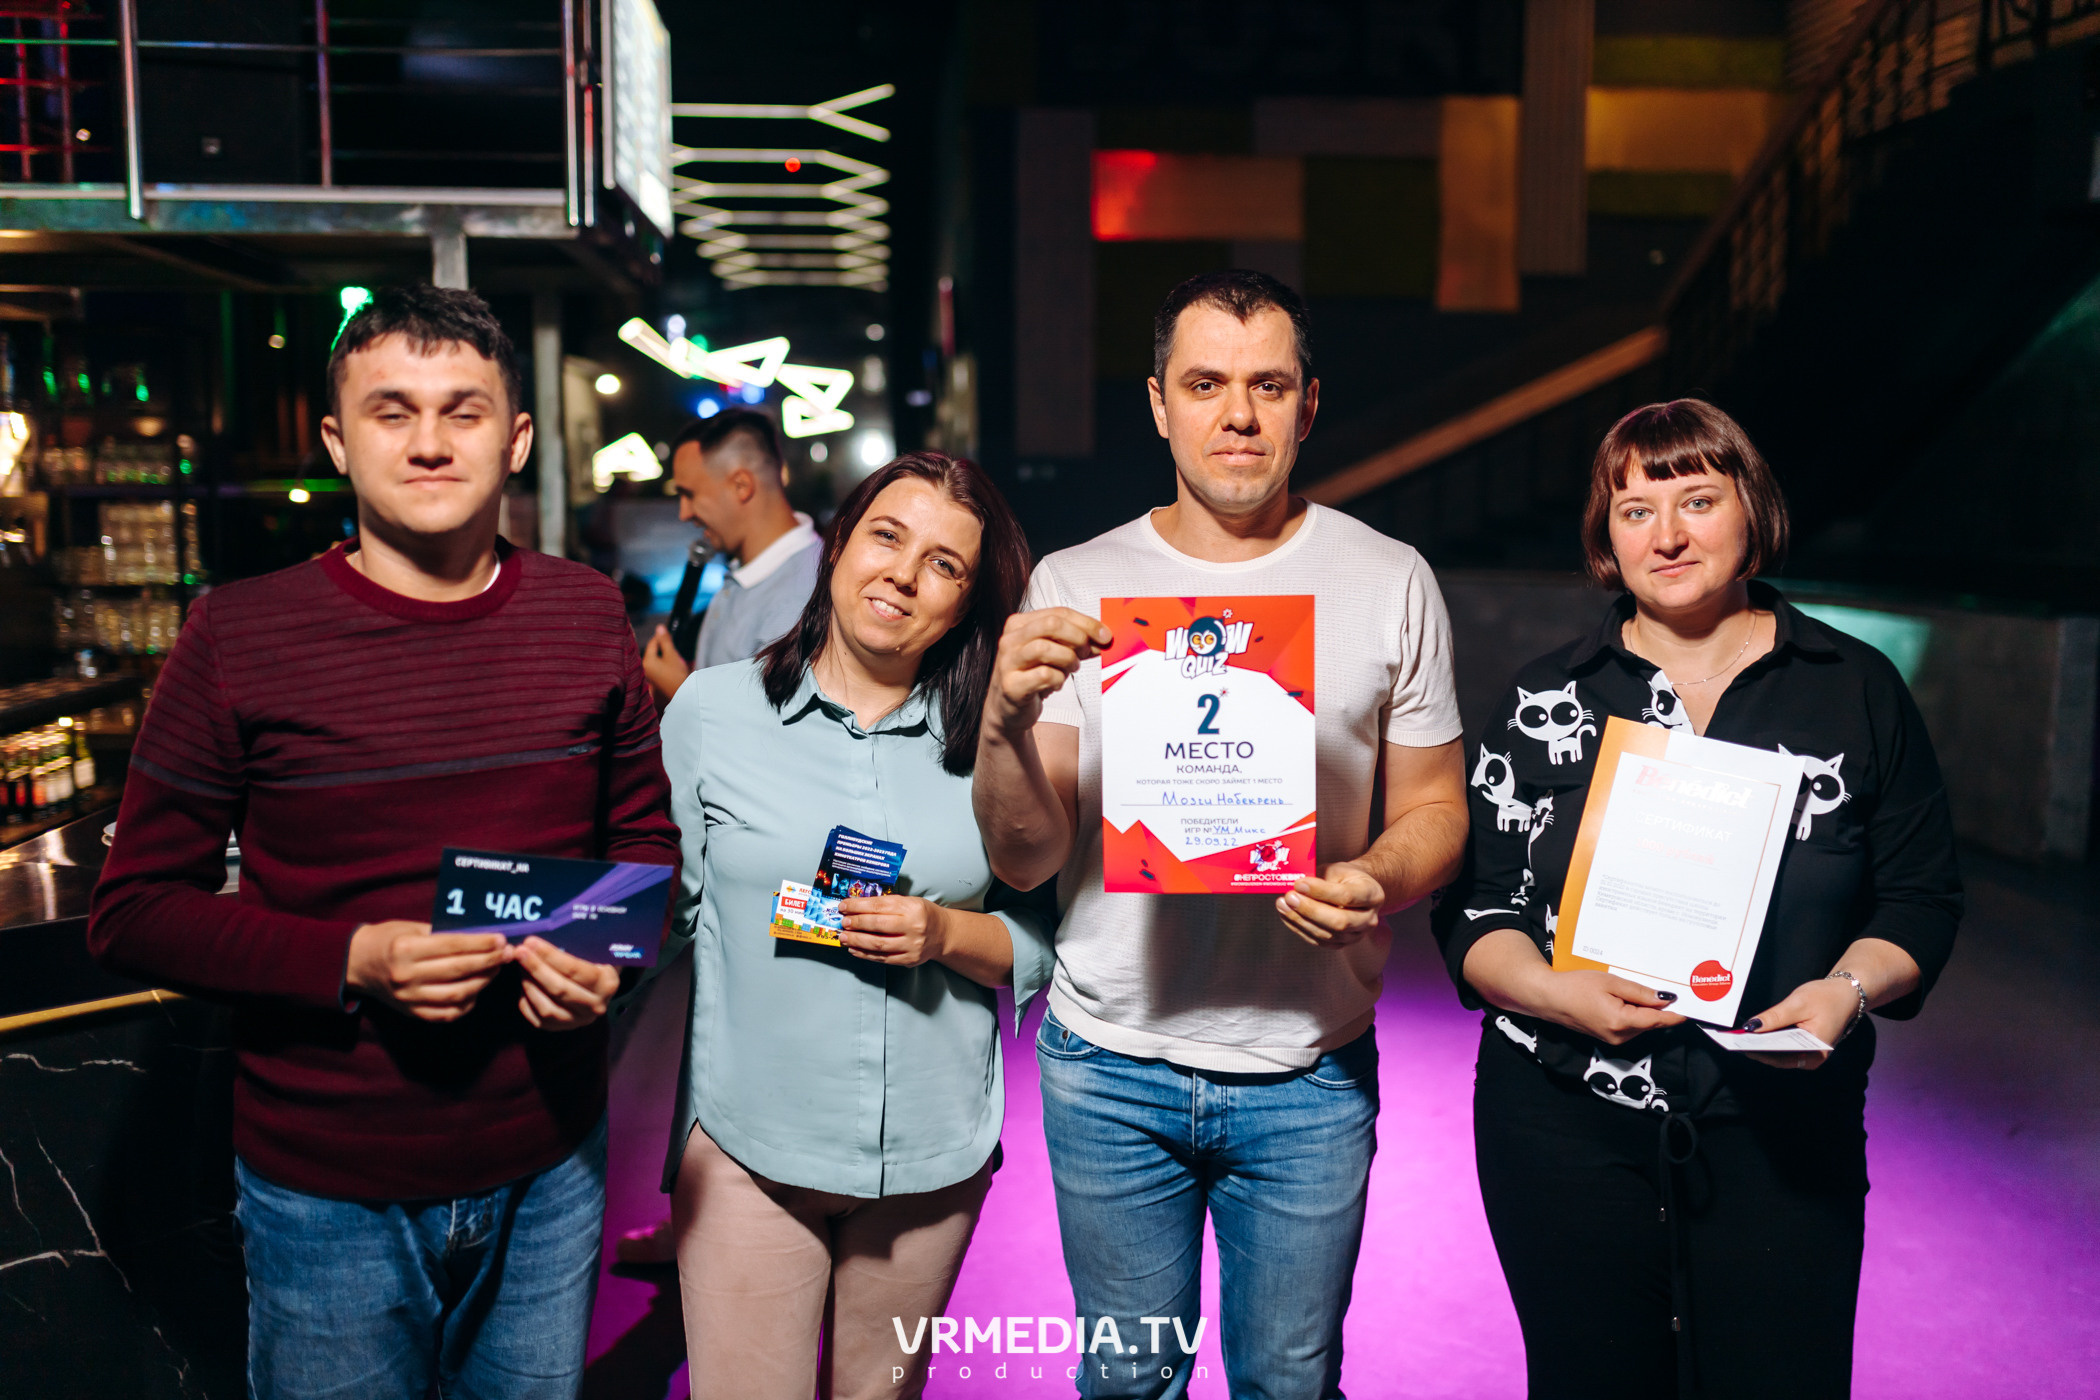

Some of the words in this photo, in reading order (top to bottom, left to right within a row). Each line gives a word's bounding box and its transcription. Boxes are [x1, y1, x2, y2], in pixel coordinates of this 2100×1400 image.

[1181, 652, 1229, 680] QUIZ
[1197, 694, 1220, 735] 2
[1164, 741, 1254, 760] МЕСТО
[1162, 791, 1213, 806] Мозги
[1217, 792, 1284, 806] Набекрень
[1180, 818, 1239, 826] ПОБЕДИТЕЛИ
[446, 888, 466, 915] 1
[485, 891, 543, 922] ЧАС
[784, 898, 805, 908] БИЛЕТ
